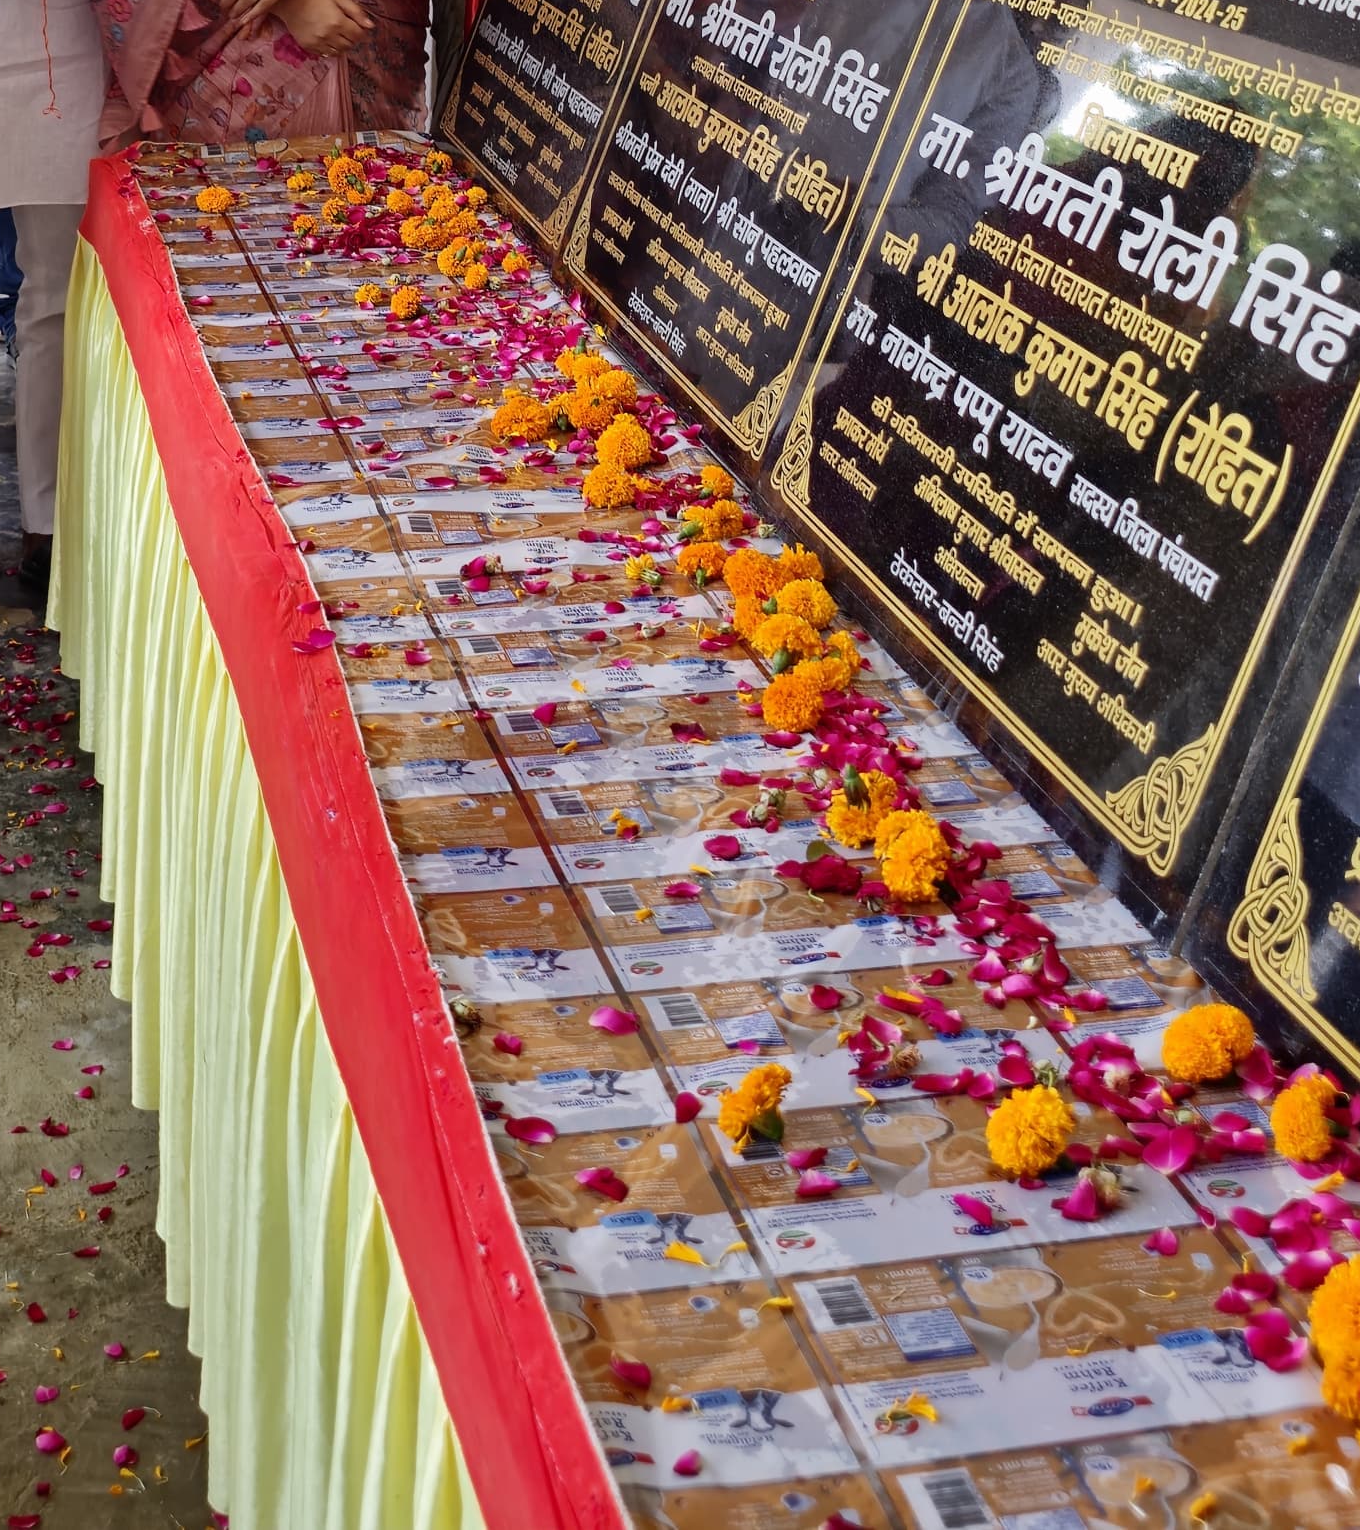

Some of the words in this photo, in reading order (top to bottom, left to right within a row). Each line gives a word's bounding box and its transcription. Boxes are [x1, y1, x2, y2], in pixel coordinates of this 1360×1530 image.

[768, 24, 832, 97] रोली
[822, 49, 890, 134] सिंह
[1036, 39, 1073, 70] मार्ग
[1065, 53, 1088, 78] का
[1133, 69, 1174, 106] लेपन
[1171, 90, 1233, 133] मरम्मत
[1229, 111, 1278, 148] कार्य
[1269, 125, 1304, 159] का
[1139, 29, 1189, 60] फाटक
[1186, 35, 1206, 70] से
[1204, 50, 1261, 96] राजपुर
[1256, 59, 1296, 101] होते
[1290, 78, 1323, 117] हुए
[656, 80, 709, 129] आलोक
[697, 109, 752, 159] कुमार
[743, 124, 784, 183] सिंह
[776, 147, 849, 234] (रोहित)
[1074, 102, 1200, 189] शिलान्यास
[616, 121, 650, 162] श्रीमती
[642, 140, 665, 175] प्रेम
[661, 153, 686, 190] देवी
[678, 167, 720, 223] (माता)
[717, 196, 737, 230] श्री
[733, 211, 764, 265] सोनू
[760, 234, 822, 295] पहलवान
[918, 113, 974, 179] मा.
[985, 132, 1124, 252] श्रीमती
[1118, 194, 1240, 312] रोली
[969, 221, 1017, 266] अध्यक्ष
[1011, 233, 1056, 288] जिला
[1050, 257, 1109, 320] पंचायत
[1103, 294, 1173, 357] अयोध्या
[1165, 330, 1209, 373] एवं
[832, 406, 867, 450] प्रभाकर
[865, 430, 893, 466] मौर्य
[880, 230, 919, 276] पत्नी
[916, 242, 957, 307] श्री
[942, 274, 1033, 356] आलोक
[1014, 320, 1109, 408] कुमार
[1094, 350, 1169, 452] सिंह
[1154, 389, 1293, 544] (रोहित)
[819, 440, 841, 470] अवर
[837, 457, 878, 503] अभियन्ता
[845, 296, 878, 346] मा.
[880, 323, 956, 401] नागेन्द्र
[953, 375, 1005, 459] पप्पू
[999, 409, 1075, 488] यादव
[1069, 473, 1119, 528] सदस्य
[1113, 497, 1161, 560] जिला
[1157, 534, 1219, 602] पंचायत
[871, 395, 892, 421] की
[890, 410, 956, 475] गरिमामयी
[952, 462, 1017, 525] उपस्थिति
[1014, 510, 1038, 539] में
[1032, 525, 1095, 590] सम्पन्न
[914, 474, 962, 525] अभिलाष
[954, 509, 994, 553] कुमार
[989, 534, 1046, 596] श्रीवास्तव
[934, 545, 986, 601] अभियन्ता
[970, 627, 1005, 673] सिंह
[1036, 638, 1066, 676] अपर
[1063, 660, 1100, 705] मुख्य
[1096, 692, 1156, 755] अधिकारी
[1071, 612, 1120, 665] मुकेश
[1114, 641, 1150, 690] जैन
[1060, 1365, 1118, 1386] Rahm
[1067, 1380, 1128, 1397] Kaffee
